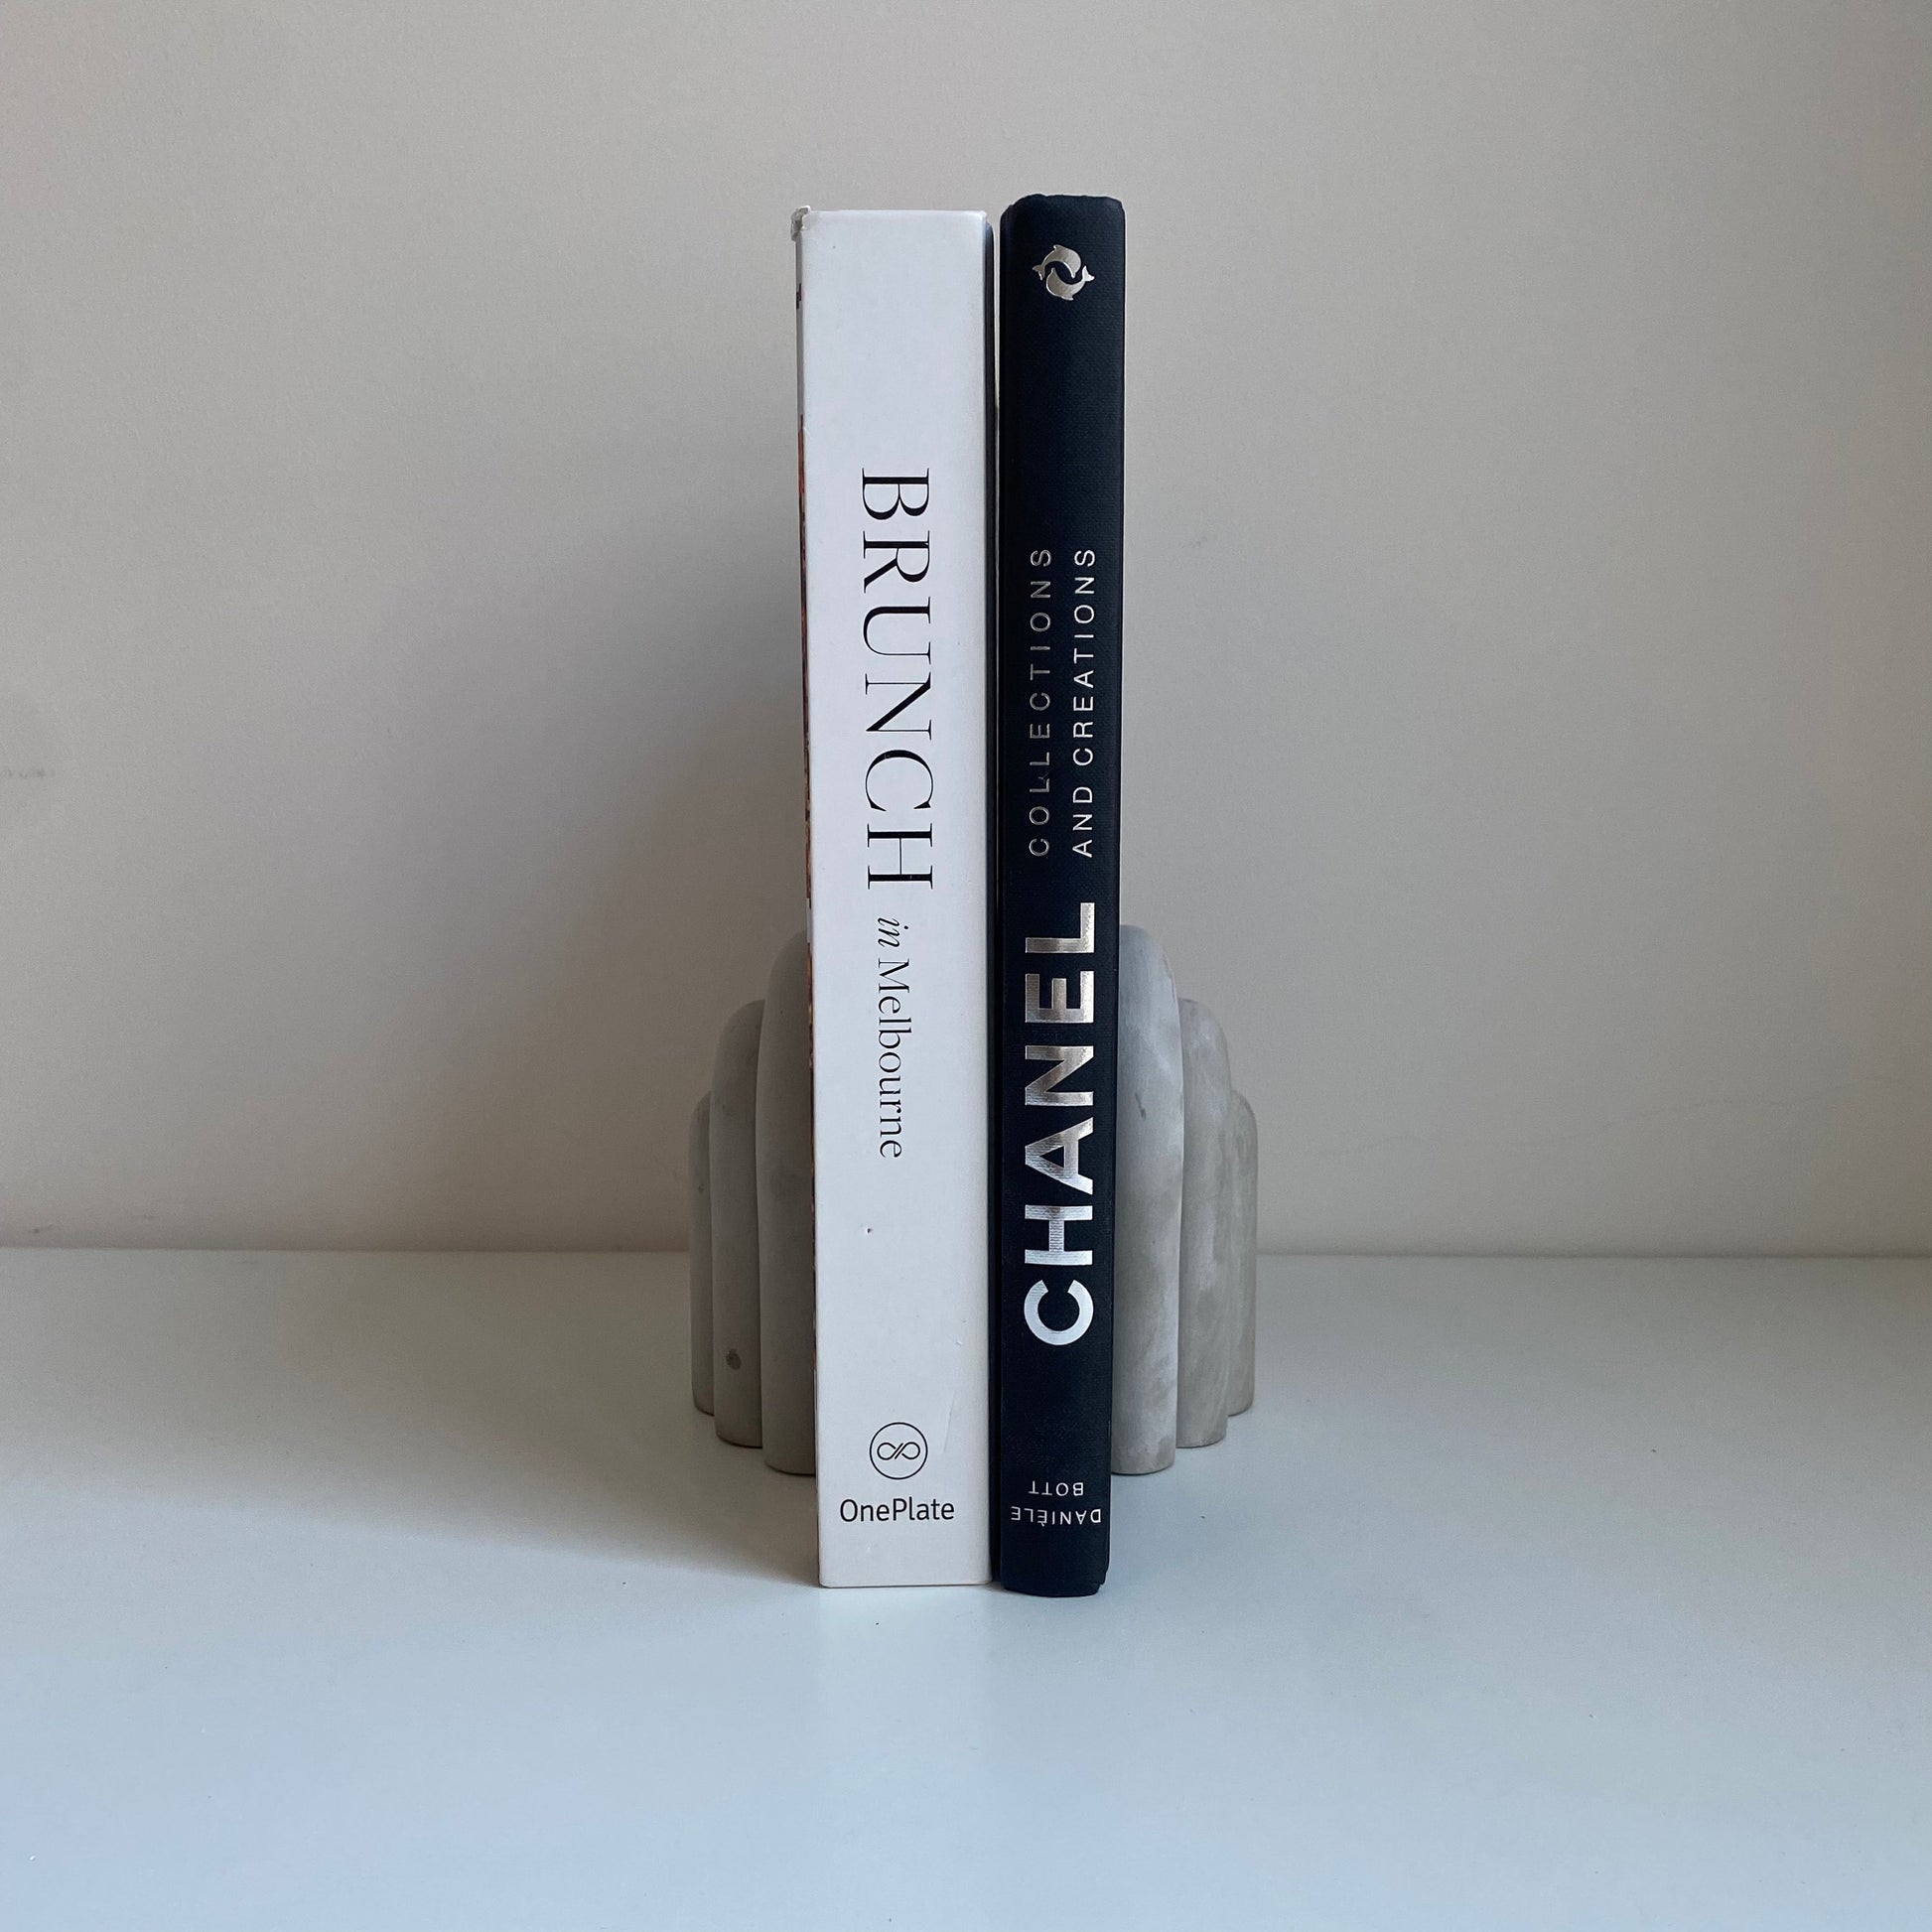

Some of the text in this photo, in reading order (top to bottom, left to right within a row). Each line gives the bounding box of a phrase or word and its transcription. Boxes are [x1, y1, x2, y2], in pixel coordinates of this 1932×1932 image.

[861, 468, 934, 1160] BRUNCH in Melbourne
[1028, 547, 1052, 859] COLLECTIONS
[1071, 548, 1097, 859] AND CREATIONS
[1024, 901, 1095, 1346] CHANEL
[839, 1496, 955, 1523] OnePlate
[1011, 1505, 1102, 1527] DANIÈLE
[1029, 1480, 1084, 1496] BOTT
